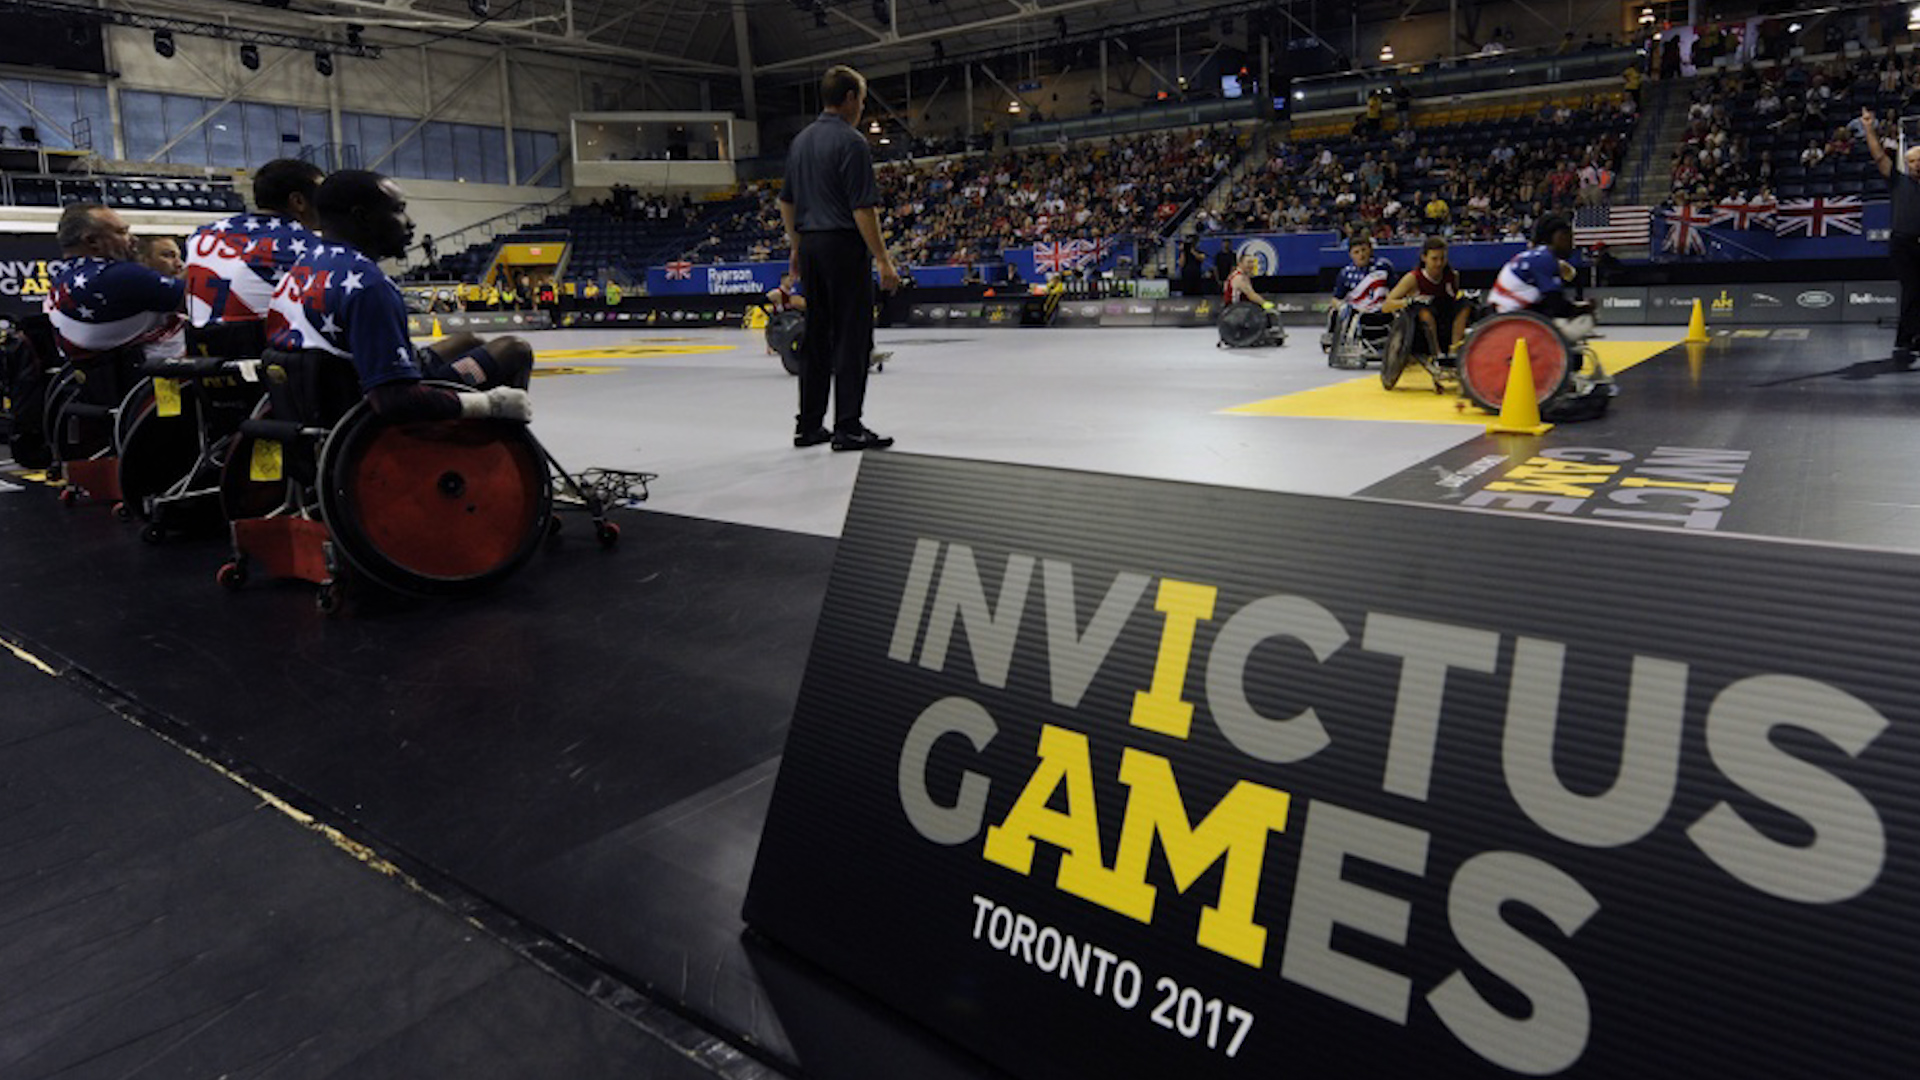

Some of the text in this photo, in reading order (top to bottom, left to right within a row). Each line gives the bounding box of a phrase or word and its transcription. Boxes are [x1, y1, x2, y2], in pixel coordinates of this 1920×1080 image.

[197, 230, 275, 267] USA
[708, 268, 752, 284] Ryerson
[708, 282, 763, 294] University
[1459, 446, 1636, 515] GAME
[1592, 446, 1752, 530] INVICT
[888, 538, 1889, 904] INVICTUS
[898, 696, 1600, 1076] GAMES
[971, 895, 1254, 1059] TORONTO 2017
